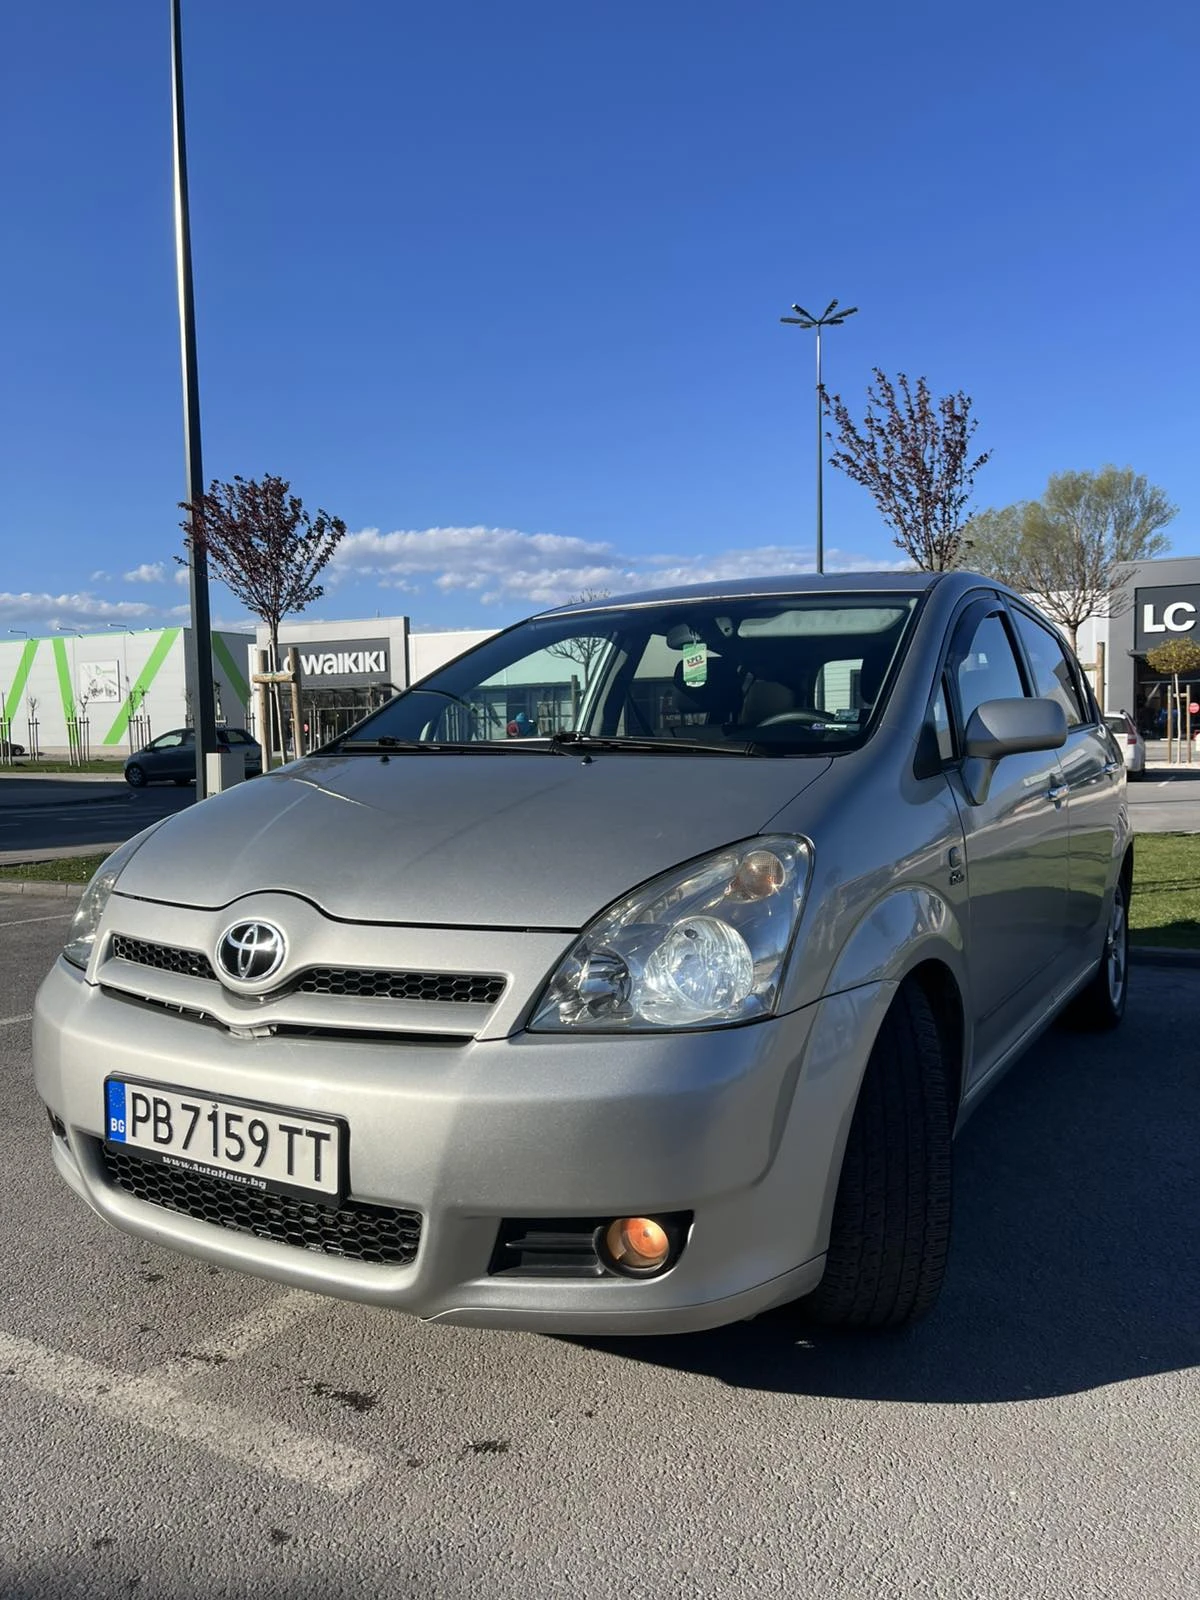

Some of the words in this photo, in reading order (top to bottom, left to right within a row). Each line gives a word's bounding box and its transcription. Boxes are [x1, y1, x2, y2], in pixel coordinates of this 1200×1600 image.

[1143, 602, 1196, 633] LC
[110, 1117, 125, 1133] BG
[132, 1092, 173, 1145] PB
[181, 1103, 269, 1168] 7159
[279, 1123, 331, 1182] TT
[162, 1156, 267, 1190] www.AutoHaus.bg
